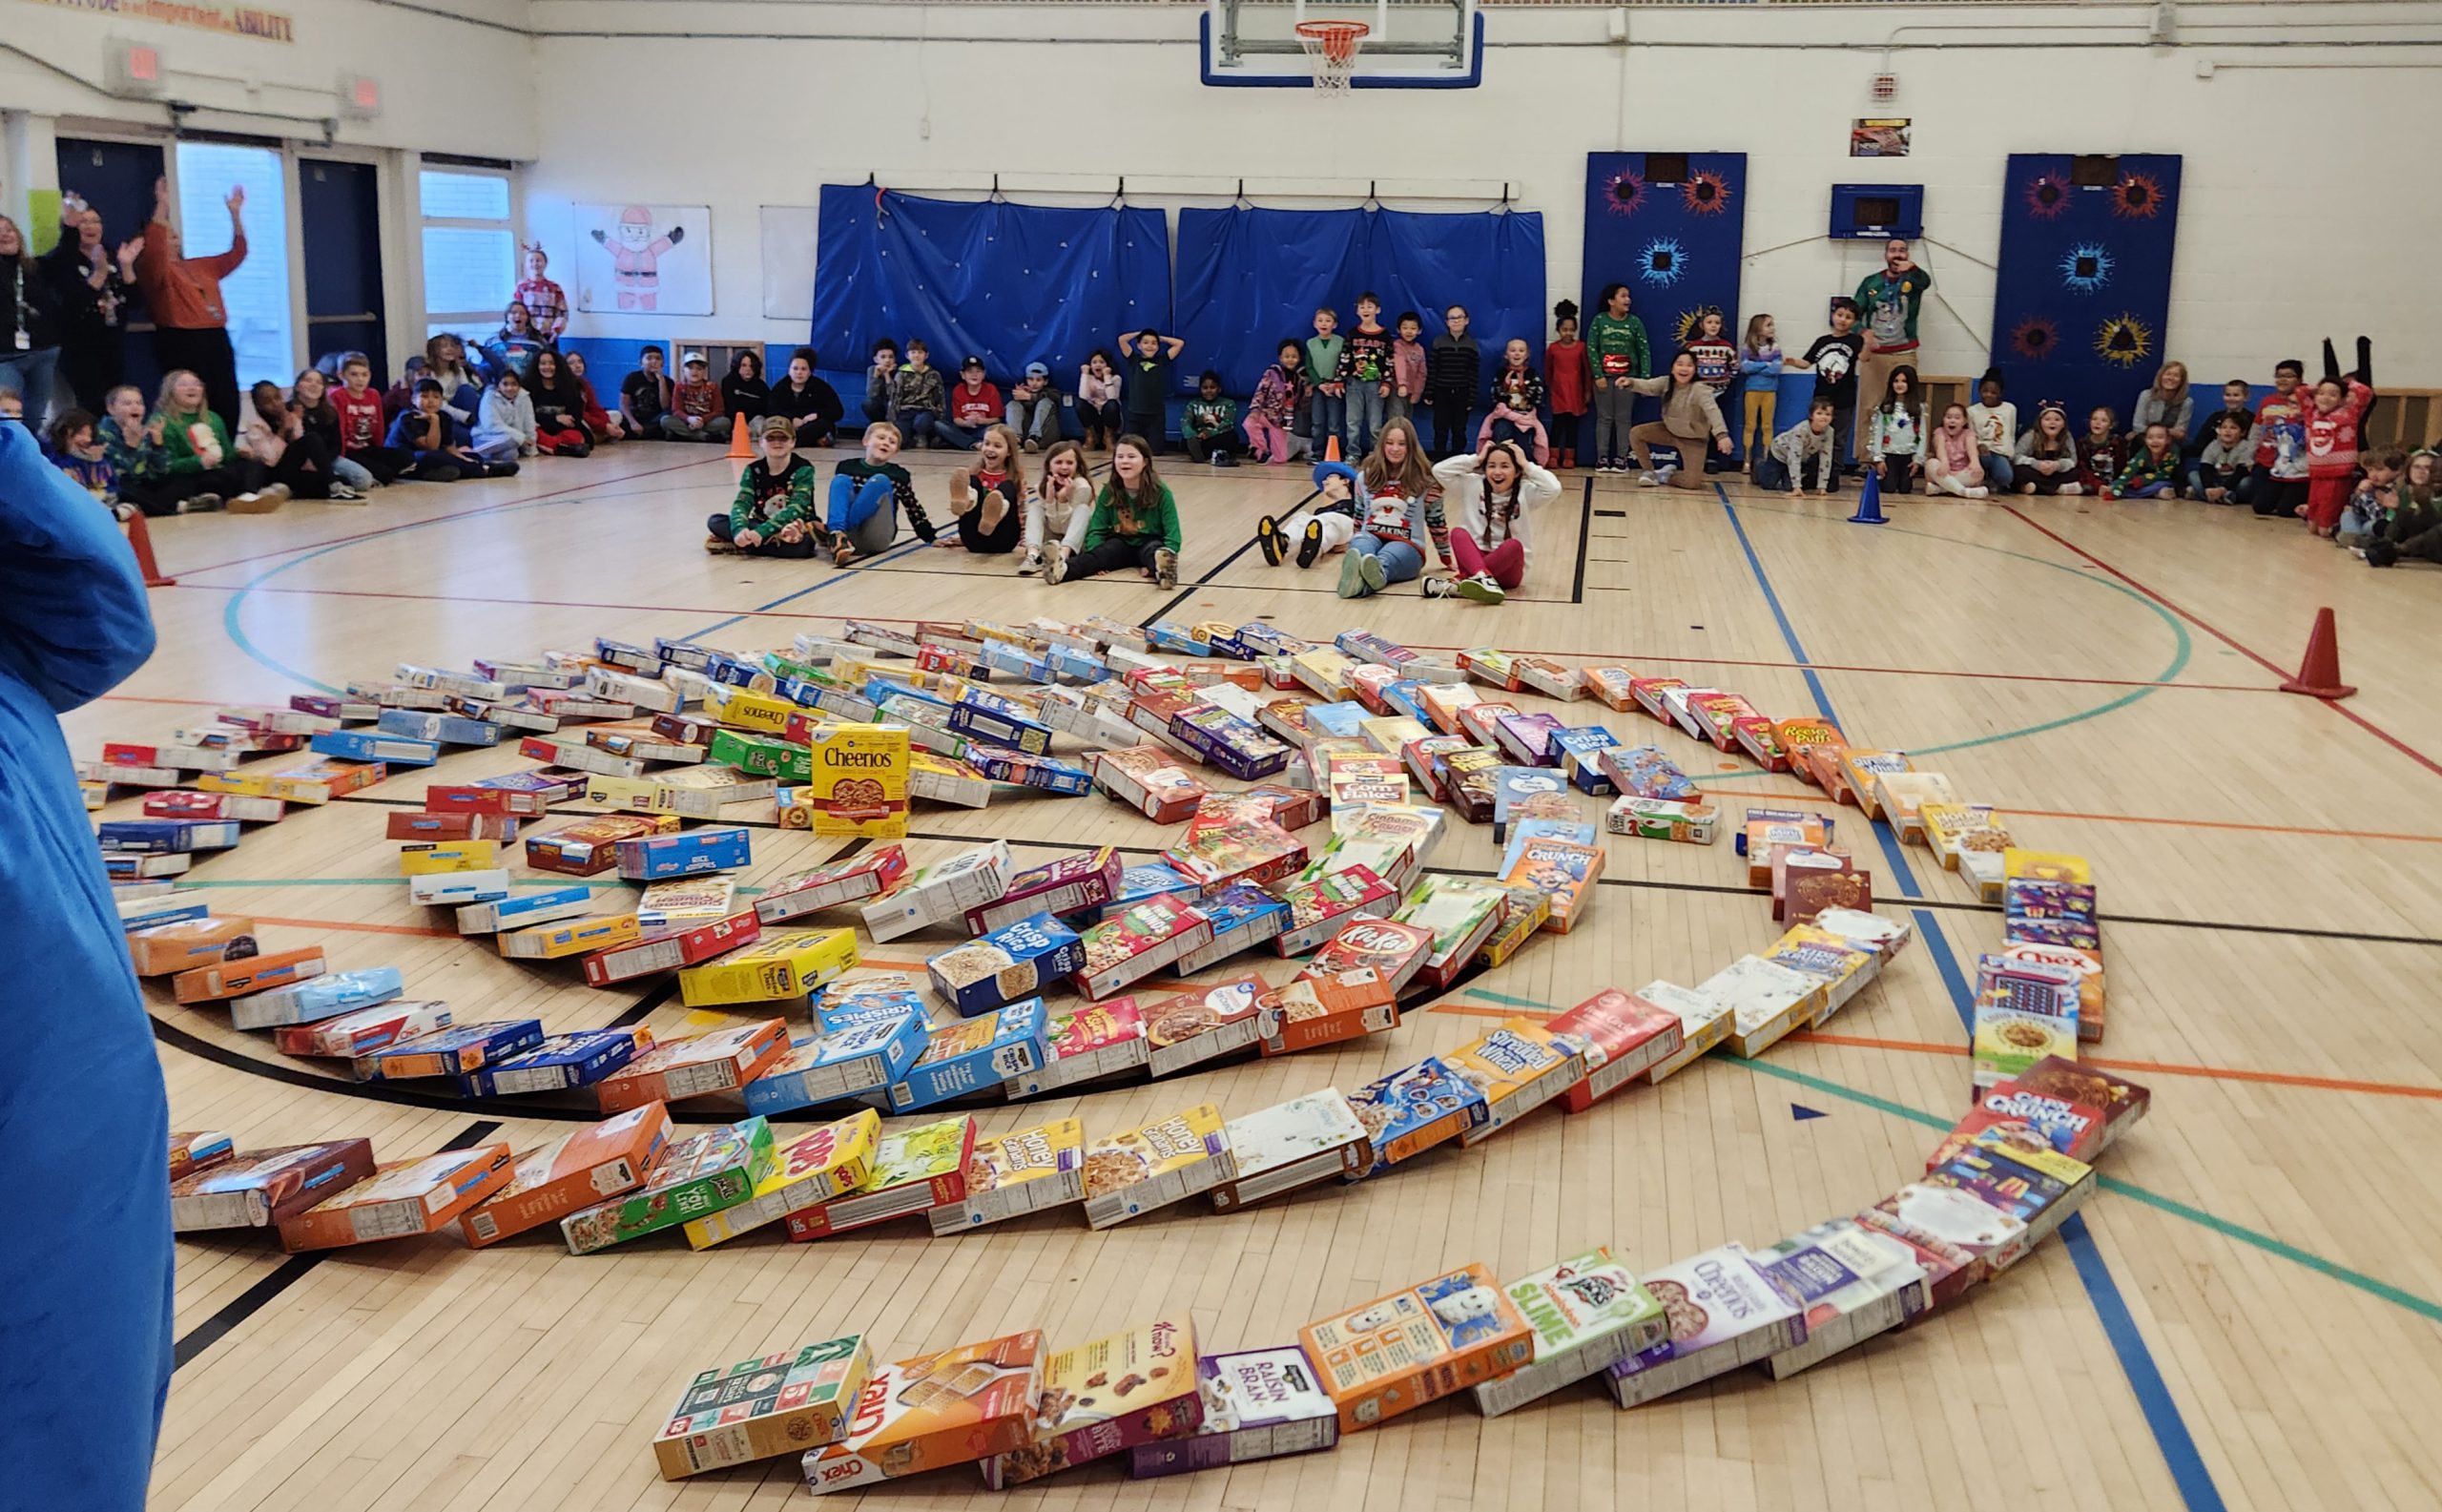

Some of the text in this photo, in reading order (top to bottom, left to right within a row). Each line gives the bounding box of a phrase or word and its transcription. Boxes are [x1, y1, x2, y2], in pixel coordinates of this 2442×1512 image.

[743, 706, 785, 725] Cheerios
[1562, 733, 1609, 746] Crisp
[824, 748, 892, 768] Cheerios
[1342, 789, 1400, 800] Flakes
[1344, 782, 1393, 793] Corn
[1368, 813, 1424, 827] Cinnamon
[692, 855, 709, 863] RICE
[1526, 850, 1593, 865] CRUNCH
[995, 931, 1026, 952] Rice
[1010, 921, 1051, 949] Crisp
[1053, 953, 1065, 973] Rice
[1058, 945, 1073, 973] Crisp
[2017, 950, 2087, 970] Chex
[827, 1004, 913, 1025] KRISPIES
[1007, 1047, 1020, 1072] CRISPY
[1475, 1043, 1526, 1076] Wheat
[1486, 1028, 1558, 1070] Shredded
[1984, 1093, 2091, 1133] CRUNCH
[1141, 1127, 1178, 1160] Grahams
[1165, 1115, 1206, 1156] Honey
[1002, 1138, 1028, 1171] Grahams
[1020, 1127, 1056, 1170] Honey
[674, 1191, 692, 1215] LIKE!
[685, 1186, 706, 1212] YOU
[1694, 1259, 1752, 1320] Cheerios
[1510, 1281, 1575, 1348] SLIME
[811, 1344, 842, 1358] 1
[1237, 1367, 1269, 1403] BRAN
[1255, 1360, 1291, 1403] RAISIN
[819, 1459, 864, 1482] Chex
